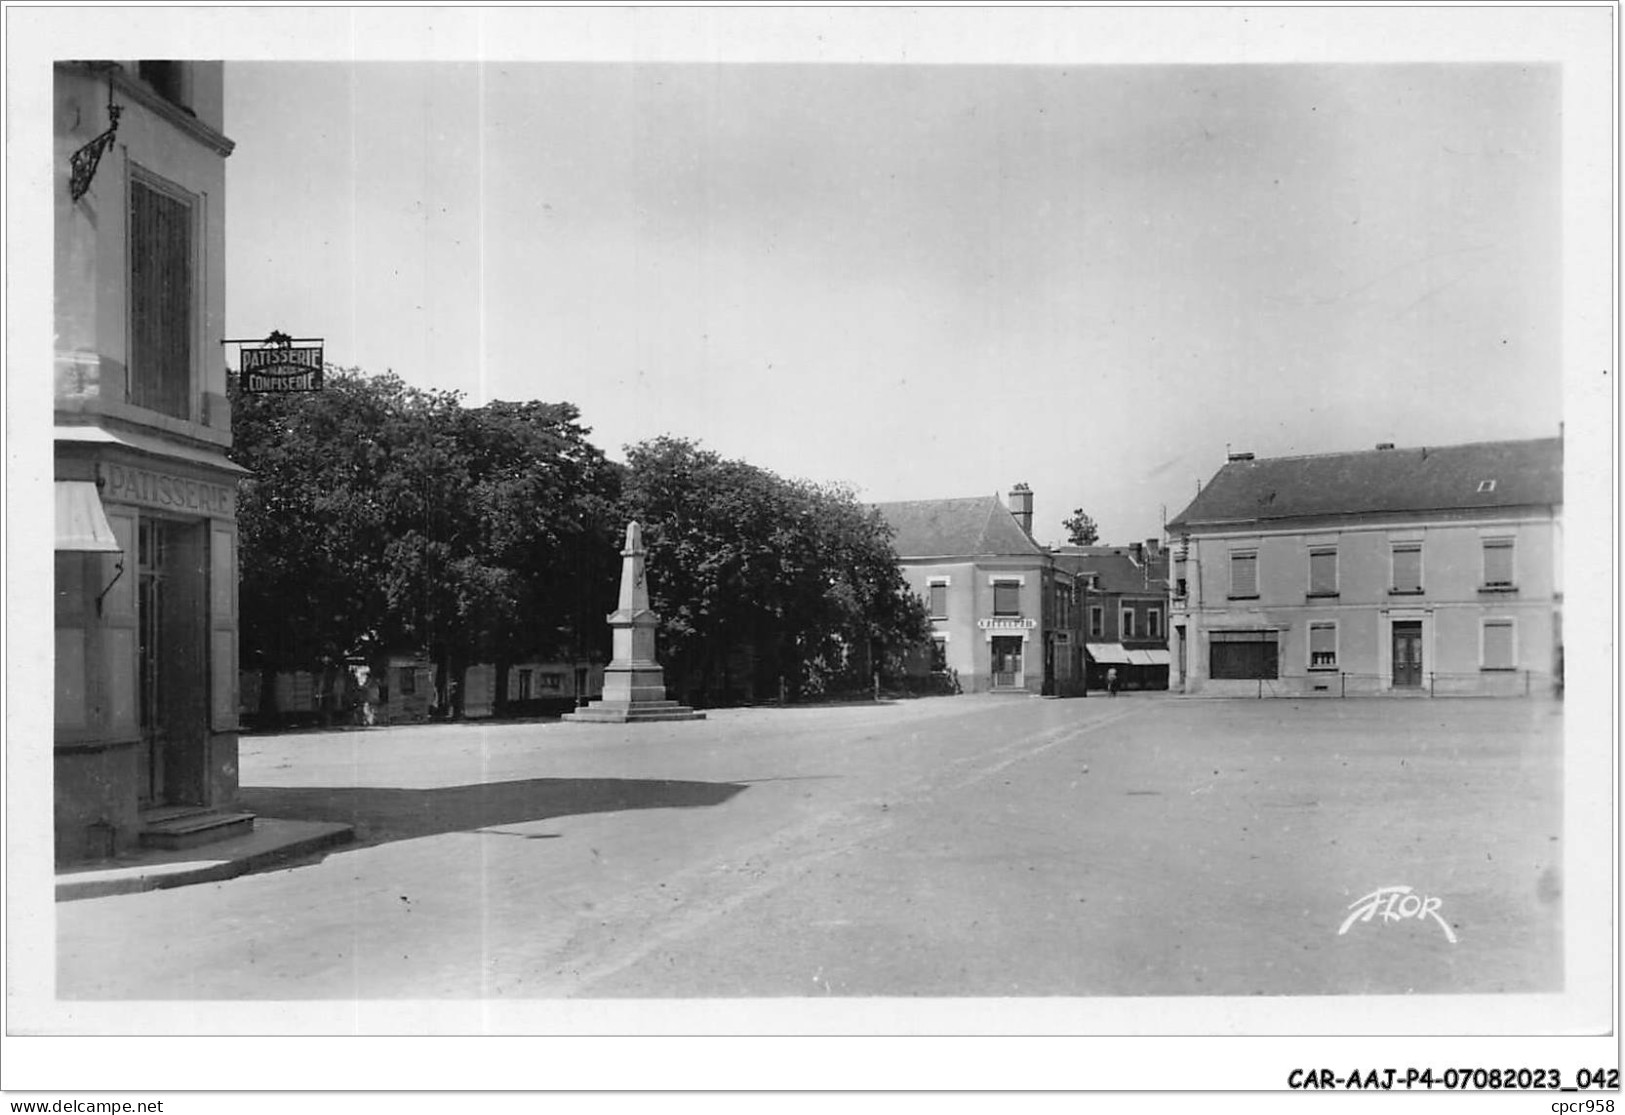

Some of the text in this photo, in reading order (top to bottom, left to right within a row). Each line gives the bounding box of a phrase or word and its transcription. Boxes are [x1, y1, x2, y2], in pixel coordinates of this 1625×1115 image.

[242, 349, 321, 373] PATISSERIE
[249, 372, 315, 392] CONFISERIE
[109, 462, 230, 514] PATISSERIE
